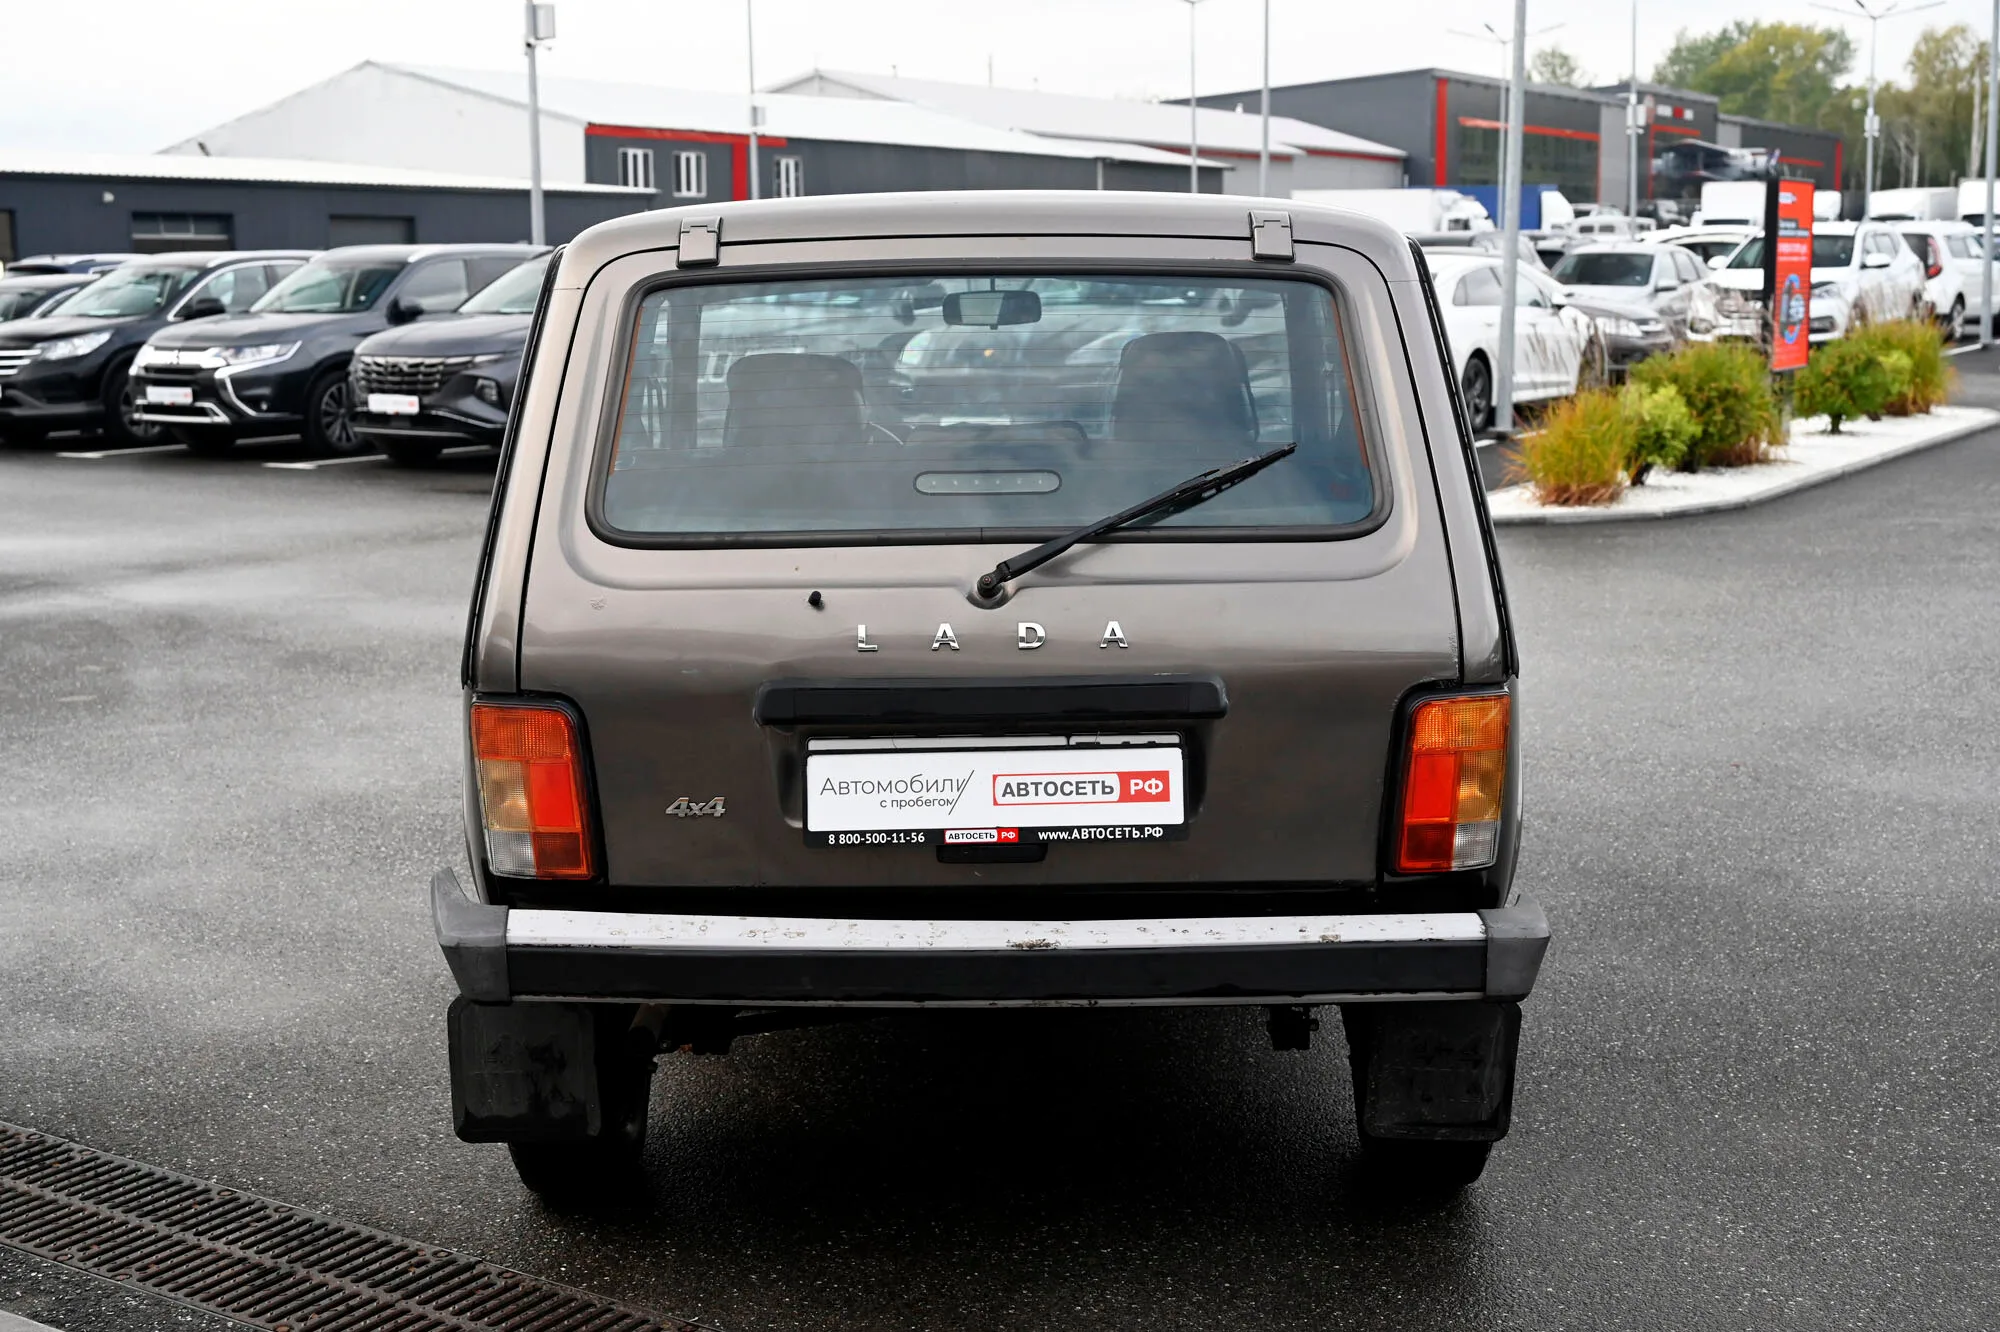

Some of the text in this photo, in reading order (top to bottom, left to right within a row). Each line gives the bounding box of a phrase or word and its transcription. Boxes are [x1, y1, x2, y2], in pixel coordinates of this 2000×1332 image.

[857, 621, 1129, 651] LADA
[1001, 778, 1164, 797] АВТОСЕТЬ РФ
[665, 796, 726, 817] 4x4
[879, 799, 887, 808] с
[828, 832, 925, 844] 8 800-500-11-56
[948, 830, 1016, 840] АВТОСЕТЬ РФ
[1038, 827, 1163, 840] www.АВТОСЕТЬ.РФ
